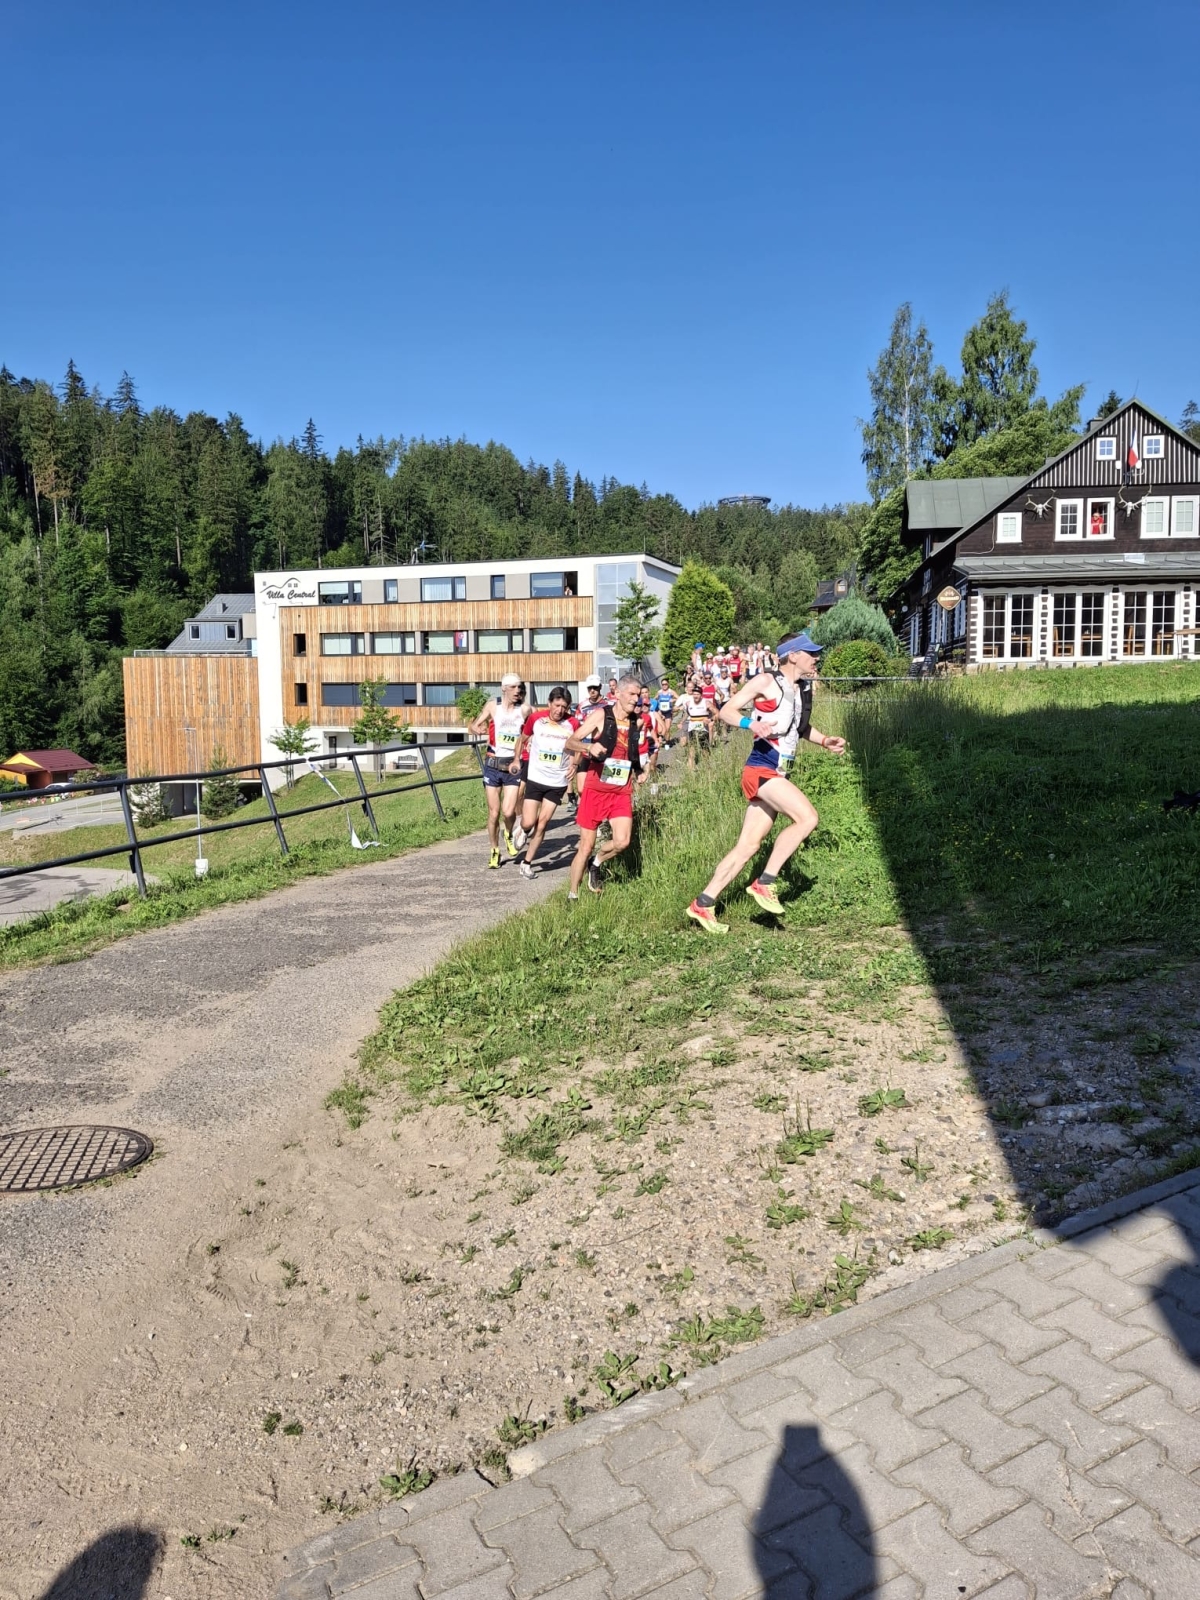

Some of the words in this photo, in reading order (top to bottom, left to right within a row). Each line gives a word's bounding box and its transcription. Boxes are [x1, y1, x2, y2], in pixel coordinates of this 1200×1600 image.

[266, 590, 285, 599] Villa
[287, 590, 315, 600] Central
[543, 753, 557, 761] 910
[612, 767, 622, 776] 18
